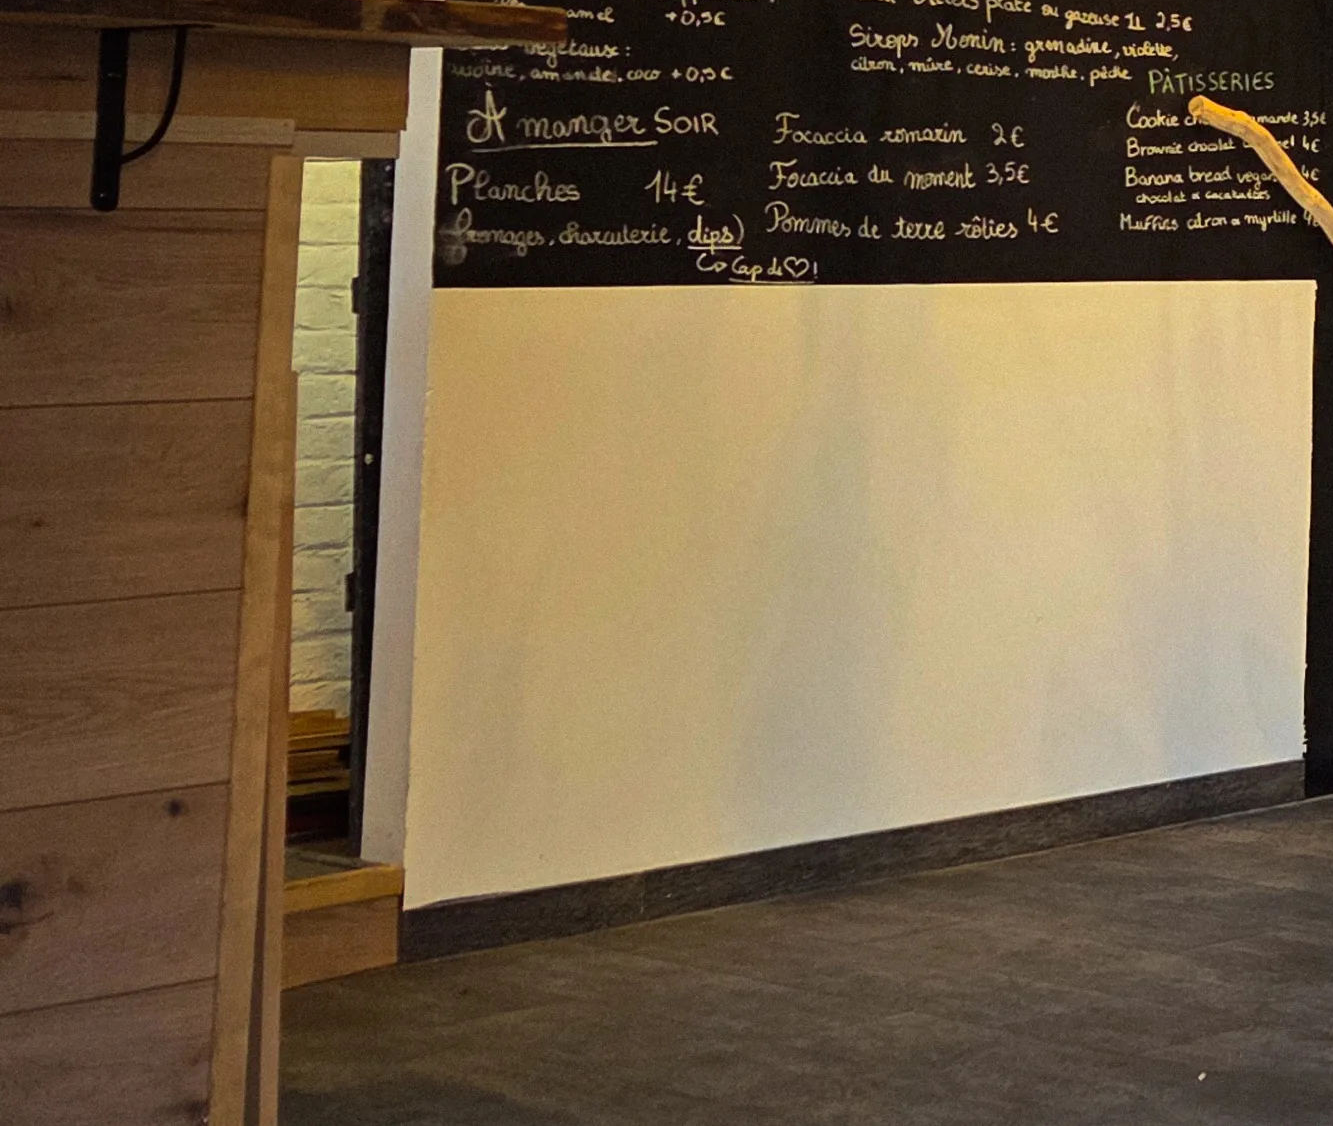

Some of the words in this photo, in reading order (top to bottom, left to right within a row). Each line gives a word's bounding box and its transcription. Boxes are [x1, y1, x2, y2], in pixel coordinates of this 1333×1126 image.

[849, 23, 919, 58] Sirops
[1148, 67, 1275, 95] PÂTISSERIES
[466, 81, 507, 144] À
[516, 114, 646, 144] manger
[655, 105, 719, 136] SOIR
[1126, 102, 1180, 129] Cookie
[772, 112, 868, 146] Focaccia
[879, 122, 968, 144] romarin
[991, 123, 1026, 148] 2€
[1126, 137, 1184, 158] Brownie
[1302, 135, 1321, 153] 4€
[445, 162, 581, 205] Planches
[644, 169, 705, 205] 14€
[769, 158, 859, 190] Focaccia
[868, 164, 894, 184] du
[904, 163, 976, 190] moment
[985, 161, 1031, 186] 3,5€
[1124, 166, 1185, 188] Banana
[1189, 166, 1233, 183] bread
[765, 200, 852, 238] Pommes
[858, 215, 881, 240] de
[891, 216, 946, 240] terre
[1027, 208, 1059, 234] 4€
